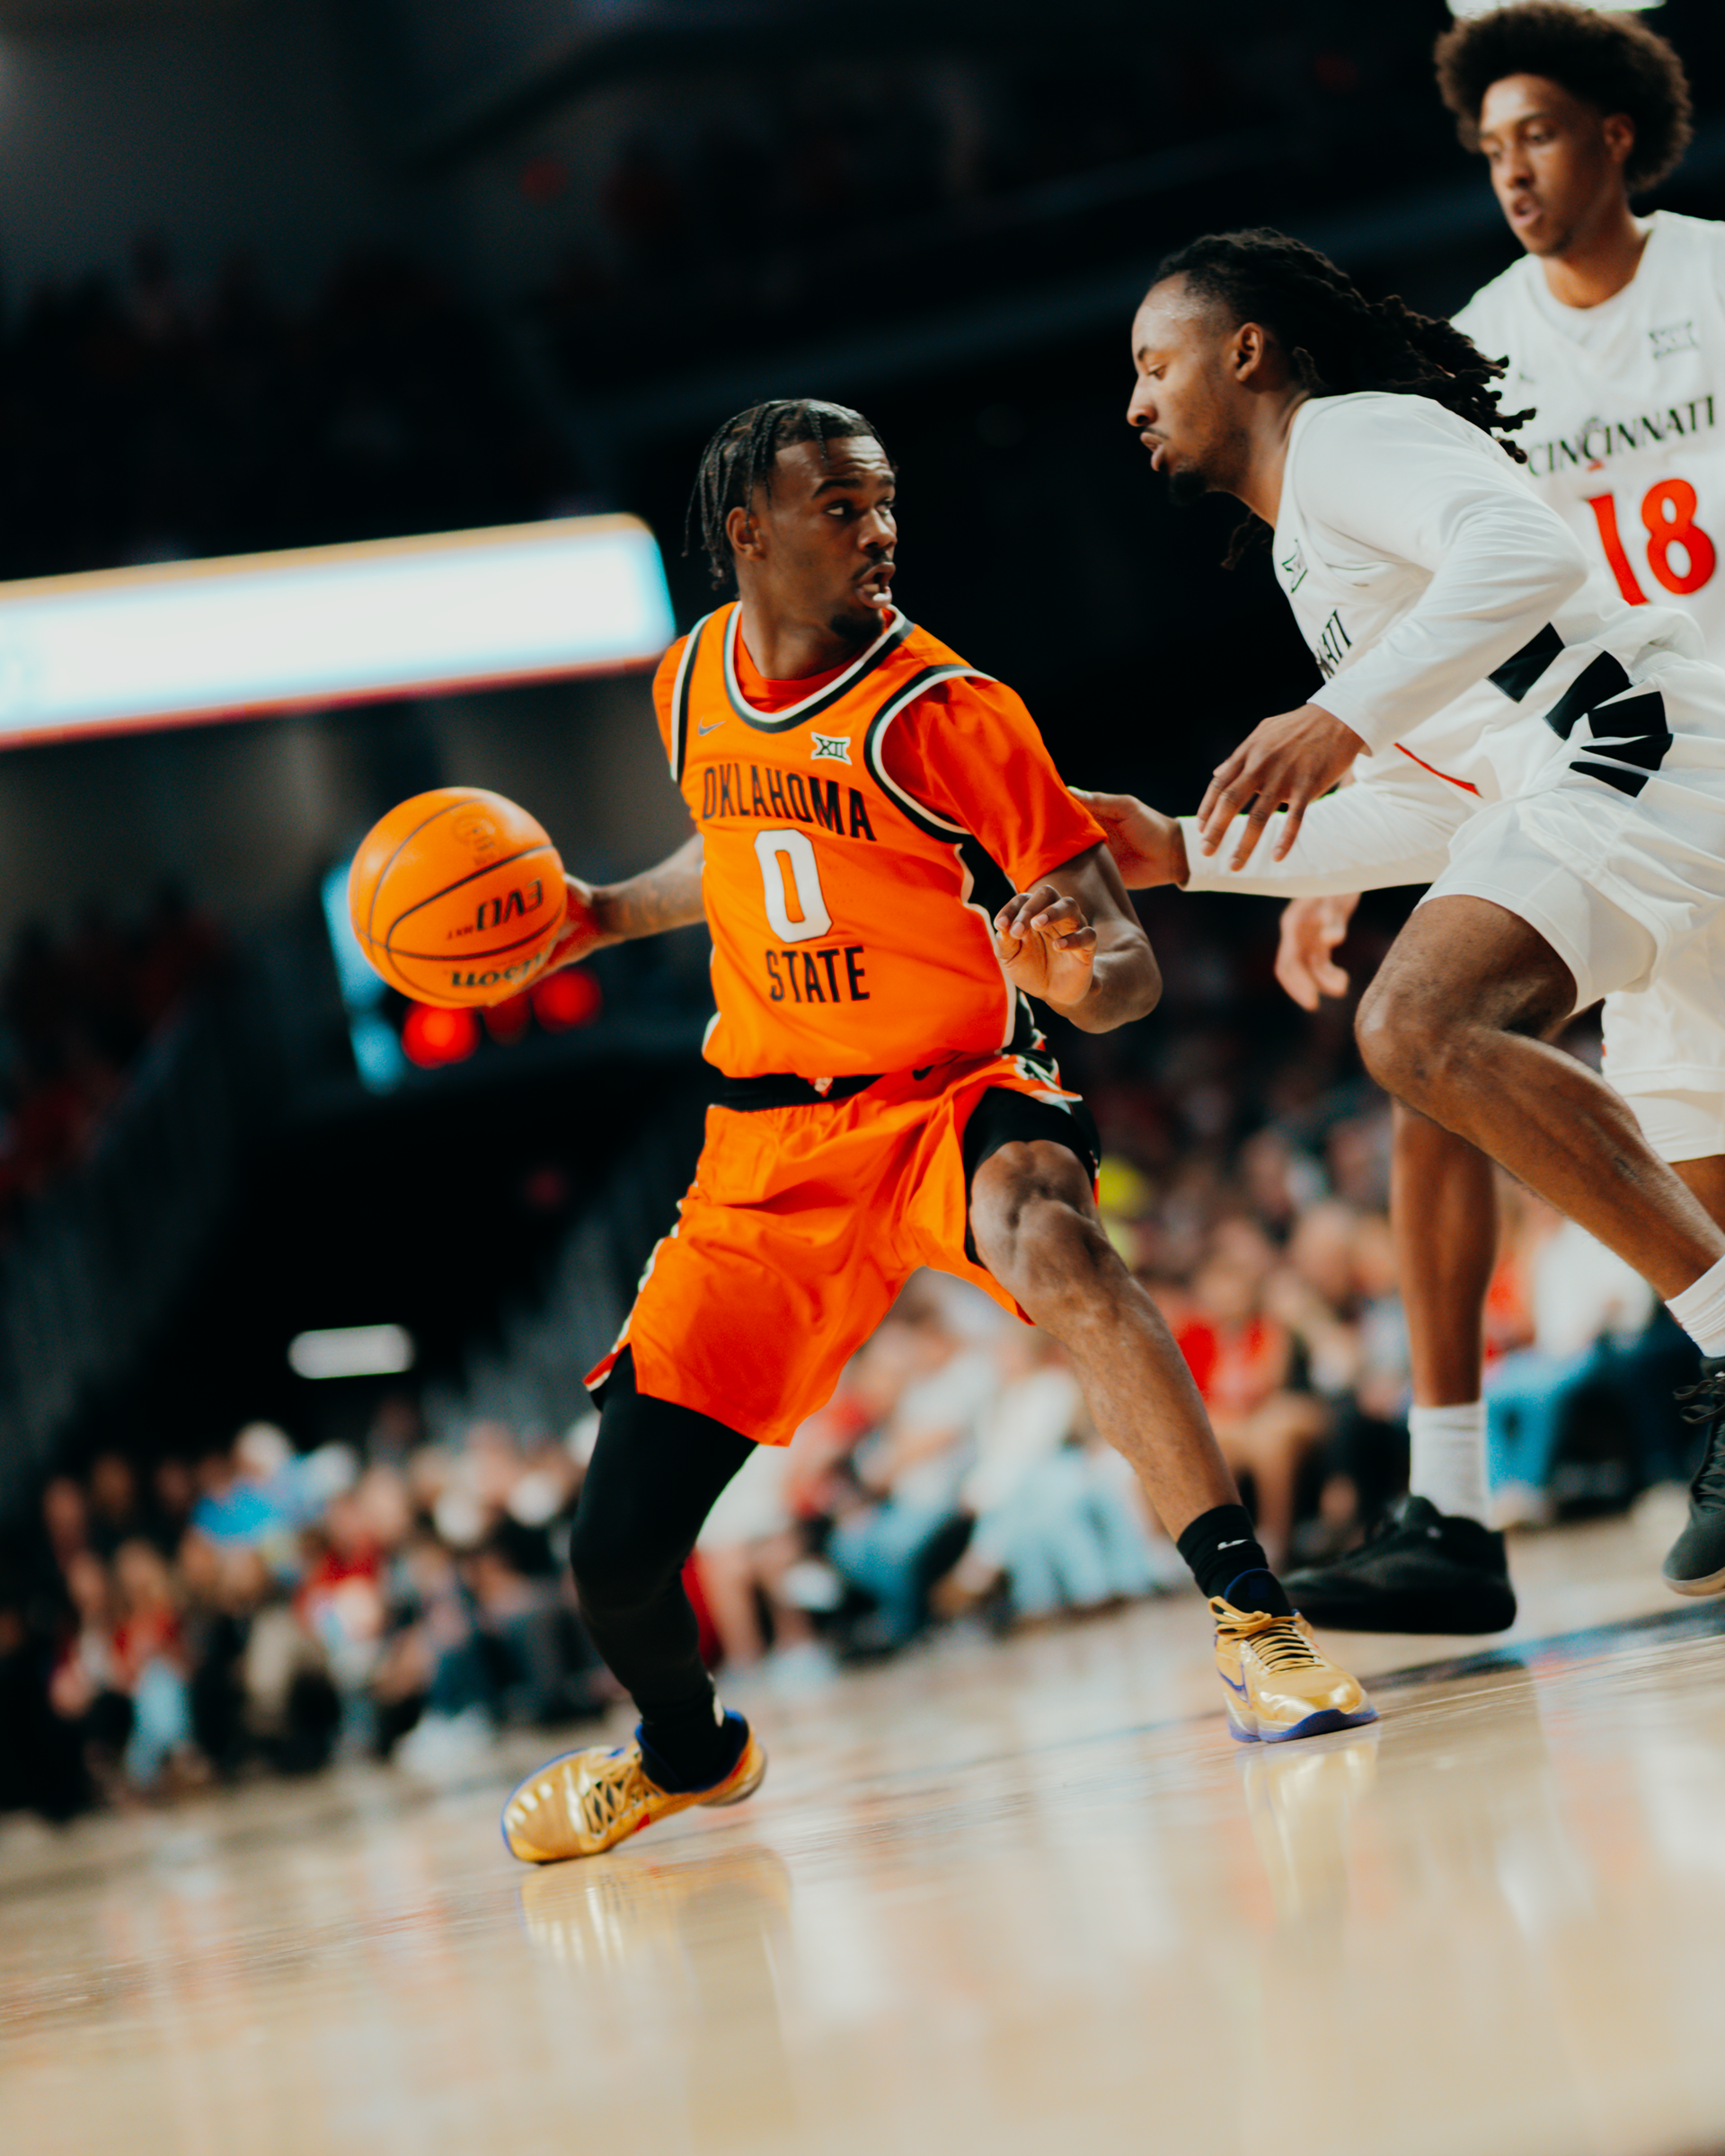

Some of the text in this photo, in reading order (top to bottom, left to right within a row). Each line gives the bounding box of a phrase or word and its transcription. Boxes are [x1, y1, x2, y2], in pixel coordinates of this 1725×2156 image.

[1527, 393, 1713, 476] CINCINNATI
[1581, 478, 1716, 606] 18
[813, 735, 849, 762] XII
[702, 763, 878, 842] OKLAHOMA
[476, 877, 544, 931] EVO
[754, 827, 834, 943] 0
[765, 945, 871, 1003] STATE
